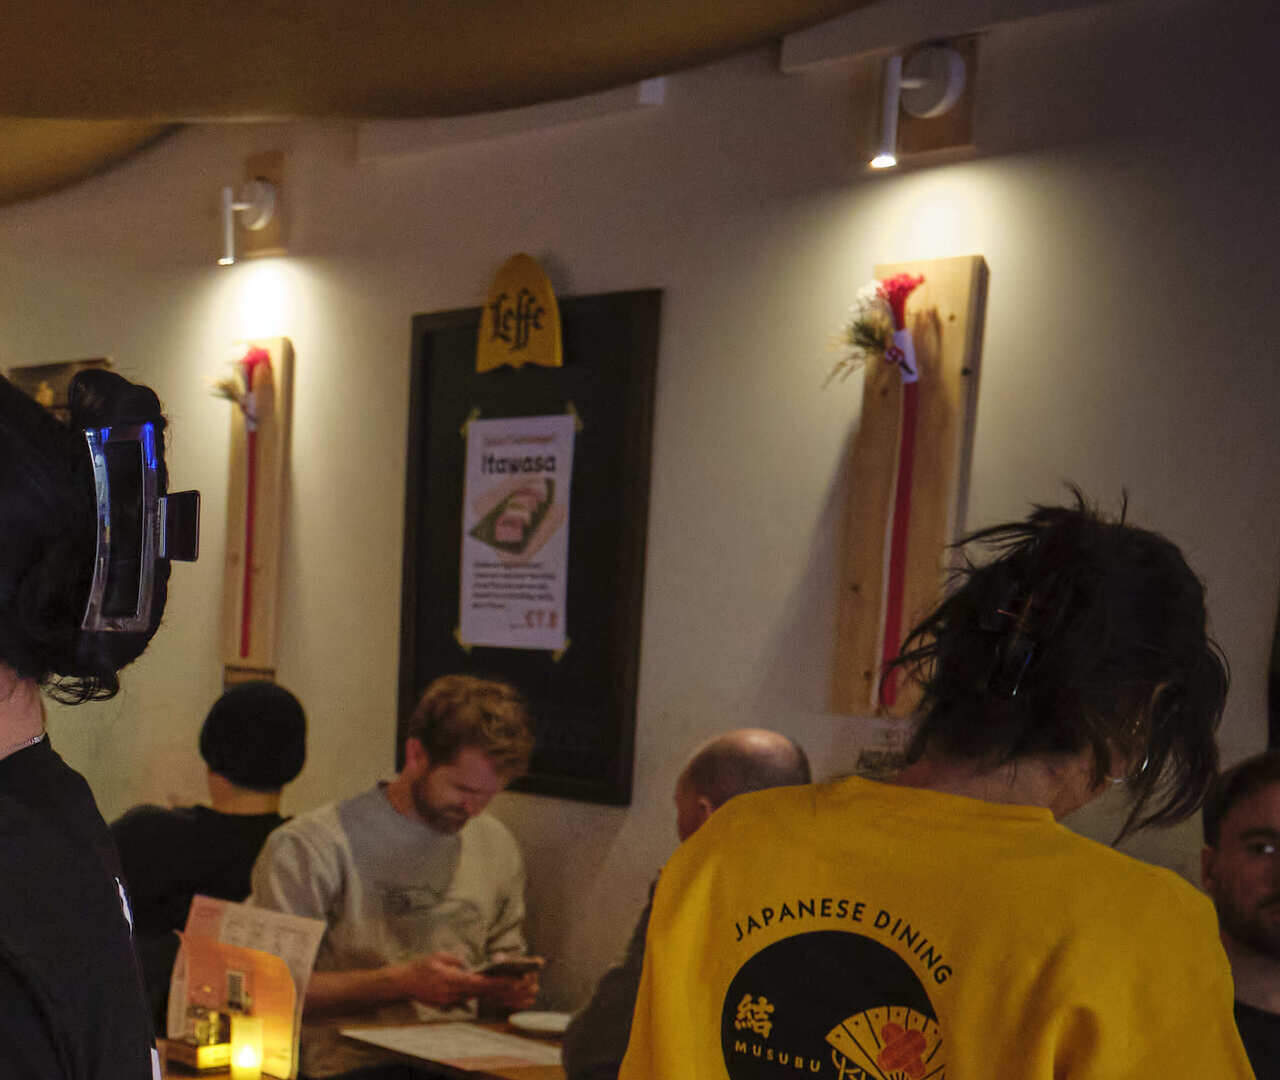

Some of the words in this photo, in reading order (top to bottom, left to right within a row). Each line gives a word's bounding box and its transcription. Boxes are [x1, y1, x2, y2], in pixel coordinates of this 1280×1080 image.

[490, 288, 545, 352] Leffe
[481, 453, 557, 475] Itawasa
[734, 897, 867, 942] JAPANESE
[873, 909, 953, 985] DINING
[734, 1039, 822, 1073] MUSUBU
